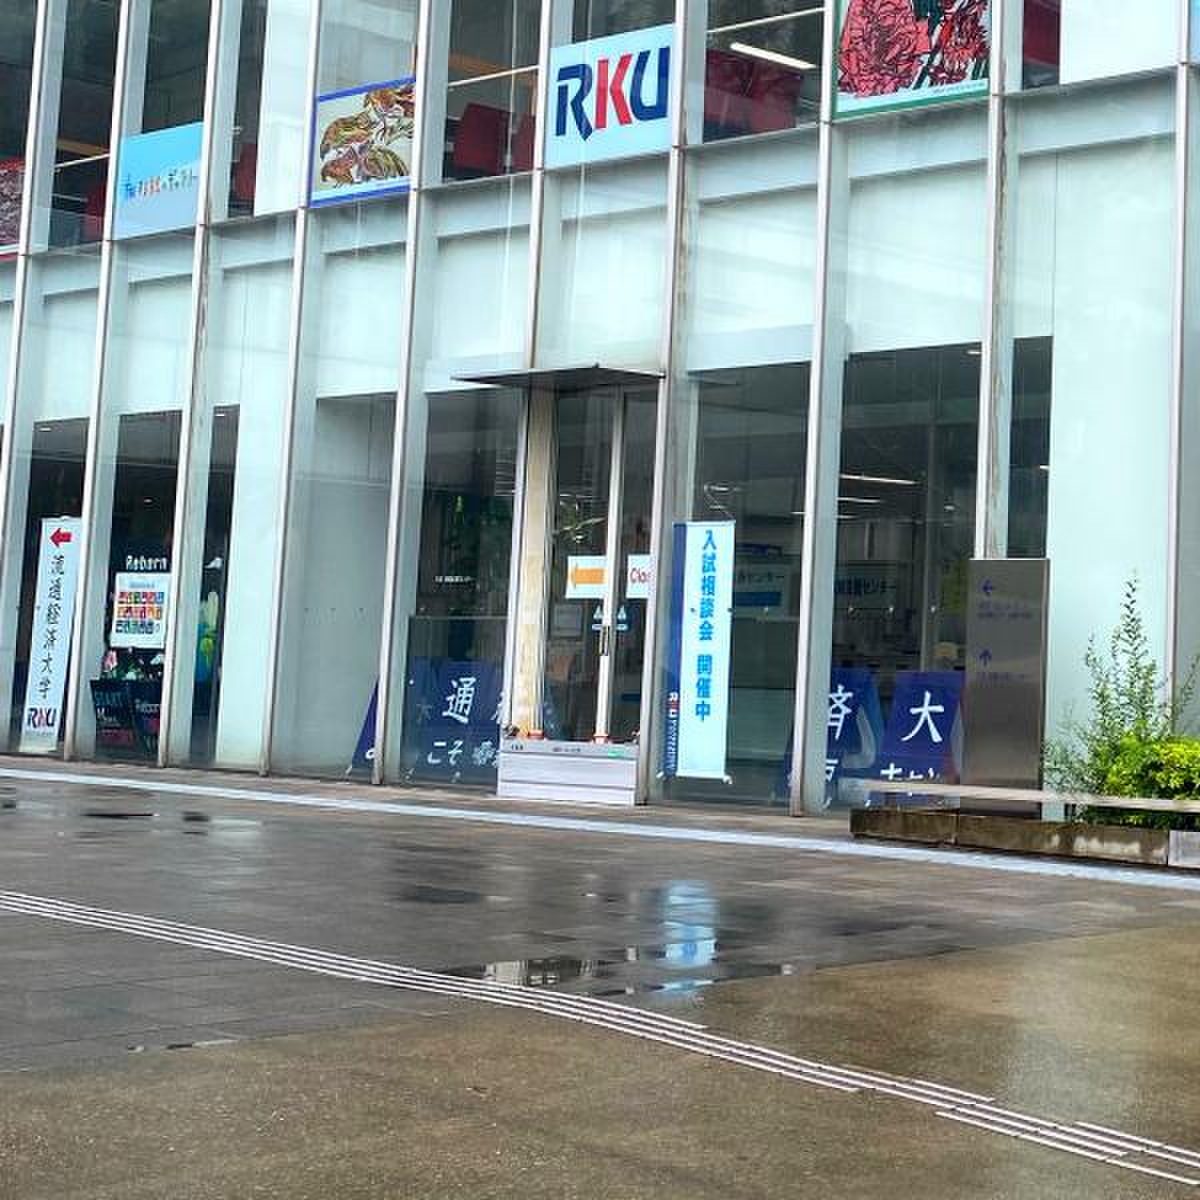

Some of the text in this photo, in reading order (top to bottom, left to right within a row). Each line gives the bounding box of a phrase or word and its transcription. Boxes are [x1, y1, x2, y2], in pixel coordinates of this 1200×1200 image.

[554, 45, 671, 142] RKU
[695, 529, 717, 721] 入試相談会 開催中
[27, 707, 57, 728] RKU
[442, 677, 477, 724] 通
[901, 690, 945, 743] 大
